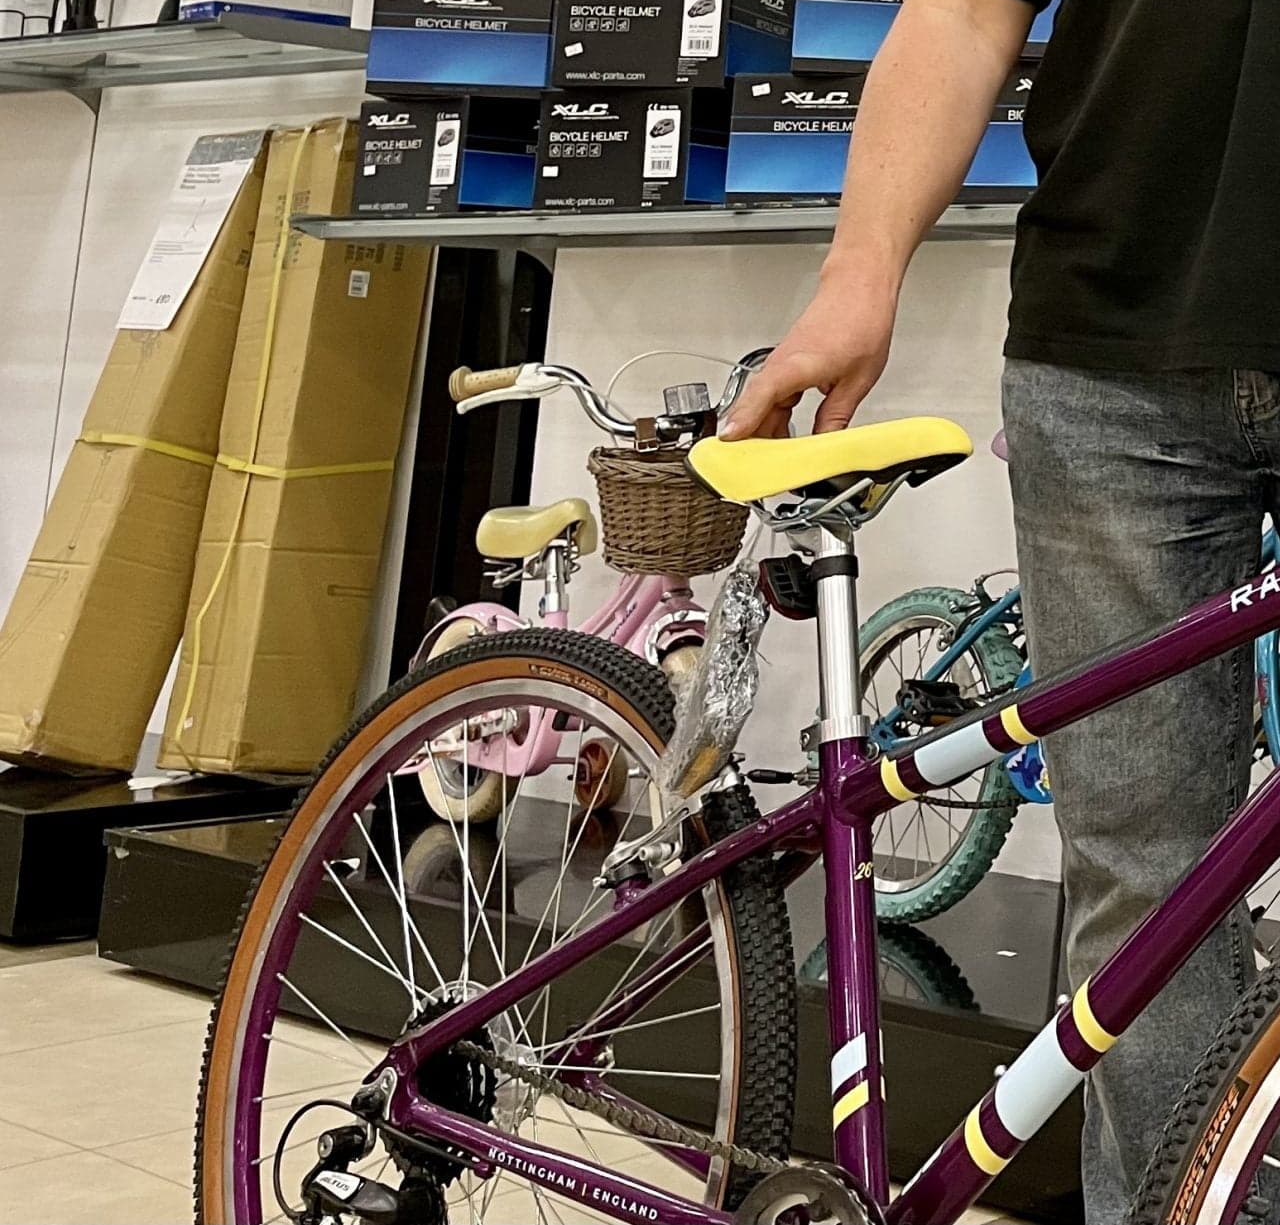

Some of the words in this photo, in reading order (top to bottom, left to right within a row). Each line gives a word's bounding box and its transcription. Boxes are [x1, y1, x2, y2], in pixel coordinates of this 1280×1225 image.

[571, 6, 616, 16] BICYCLE
[619, 7, 661, 16] HELMET
[415, 18, 461, 30] BICYCLE
[464, 19, 508, 31] HELMET
[781, 91, 849, 104] XLC
[551, 104, 609, 116] XLC
[368, 114, 410, 126] XLC
[774, 121, 820, 132] BICYCLE
[822, 121, 853, 132] HELM
[550, 132, 589, 142] BICYCLE
[591, 131, 629, 141] HELMET
[488, 1148, 577, 1190] NOTTINGHAM
[592, 1188, 659, 1221] ENGLAND
